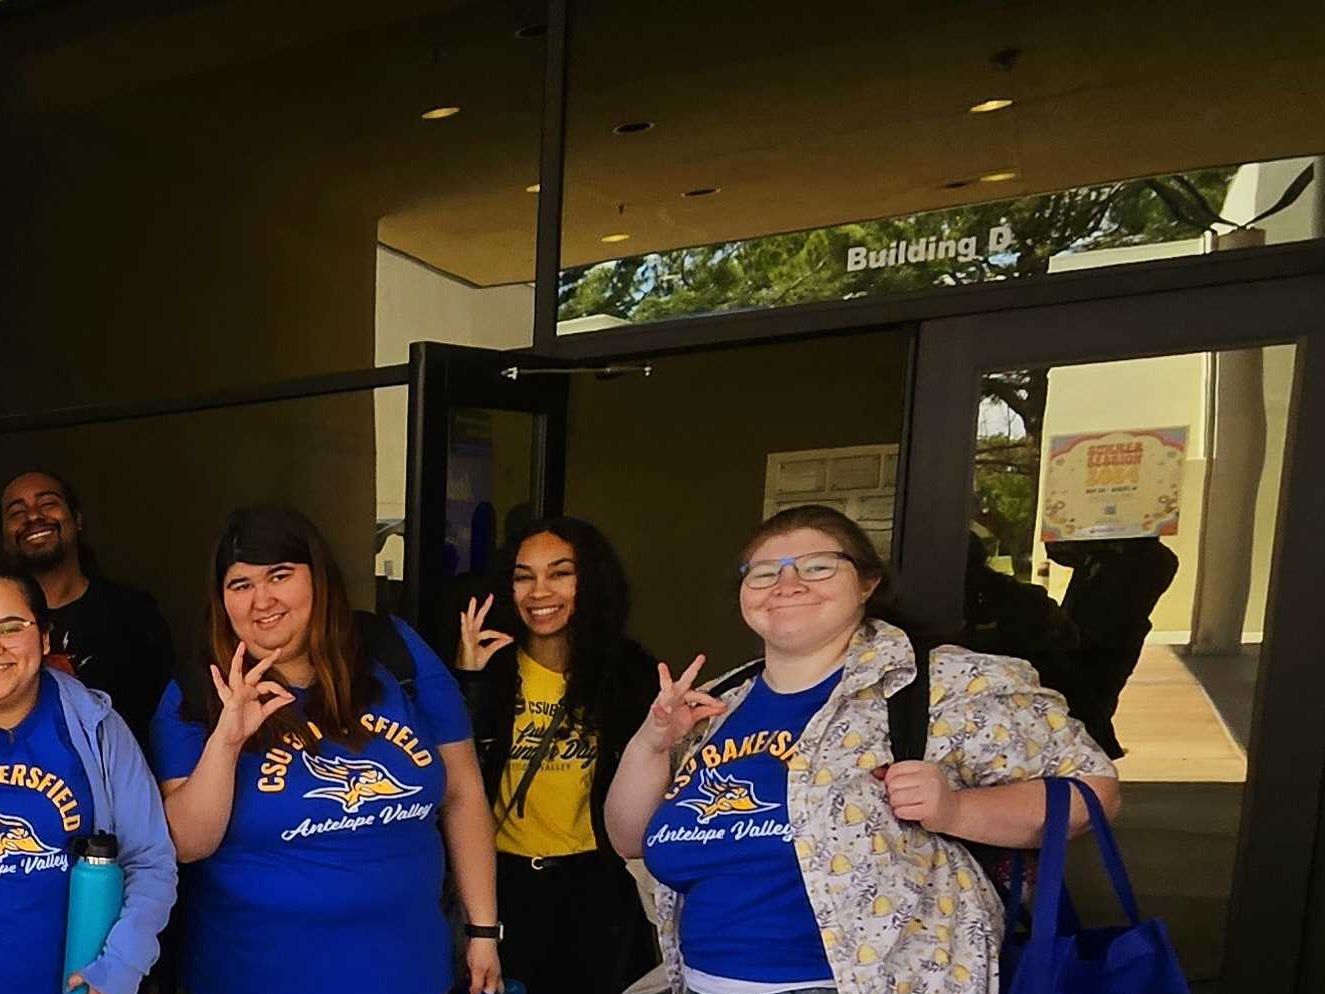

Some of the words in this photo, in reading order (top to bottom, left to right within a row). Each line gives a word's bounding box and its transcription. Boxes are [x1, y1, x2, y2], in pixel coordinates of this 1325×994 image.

[847, 236, 977, 272] Building
[989, 225, 1013, 252] D
[258, 748, 292, 792] CSU
[281, 815, 375, 841] Antelope
[379, 802, 434, 824] Valley
[646, 823, 726, 847] Antelope
[730, 819, 796, 842] Valley
[21, 853, 69, 872] Valley
